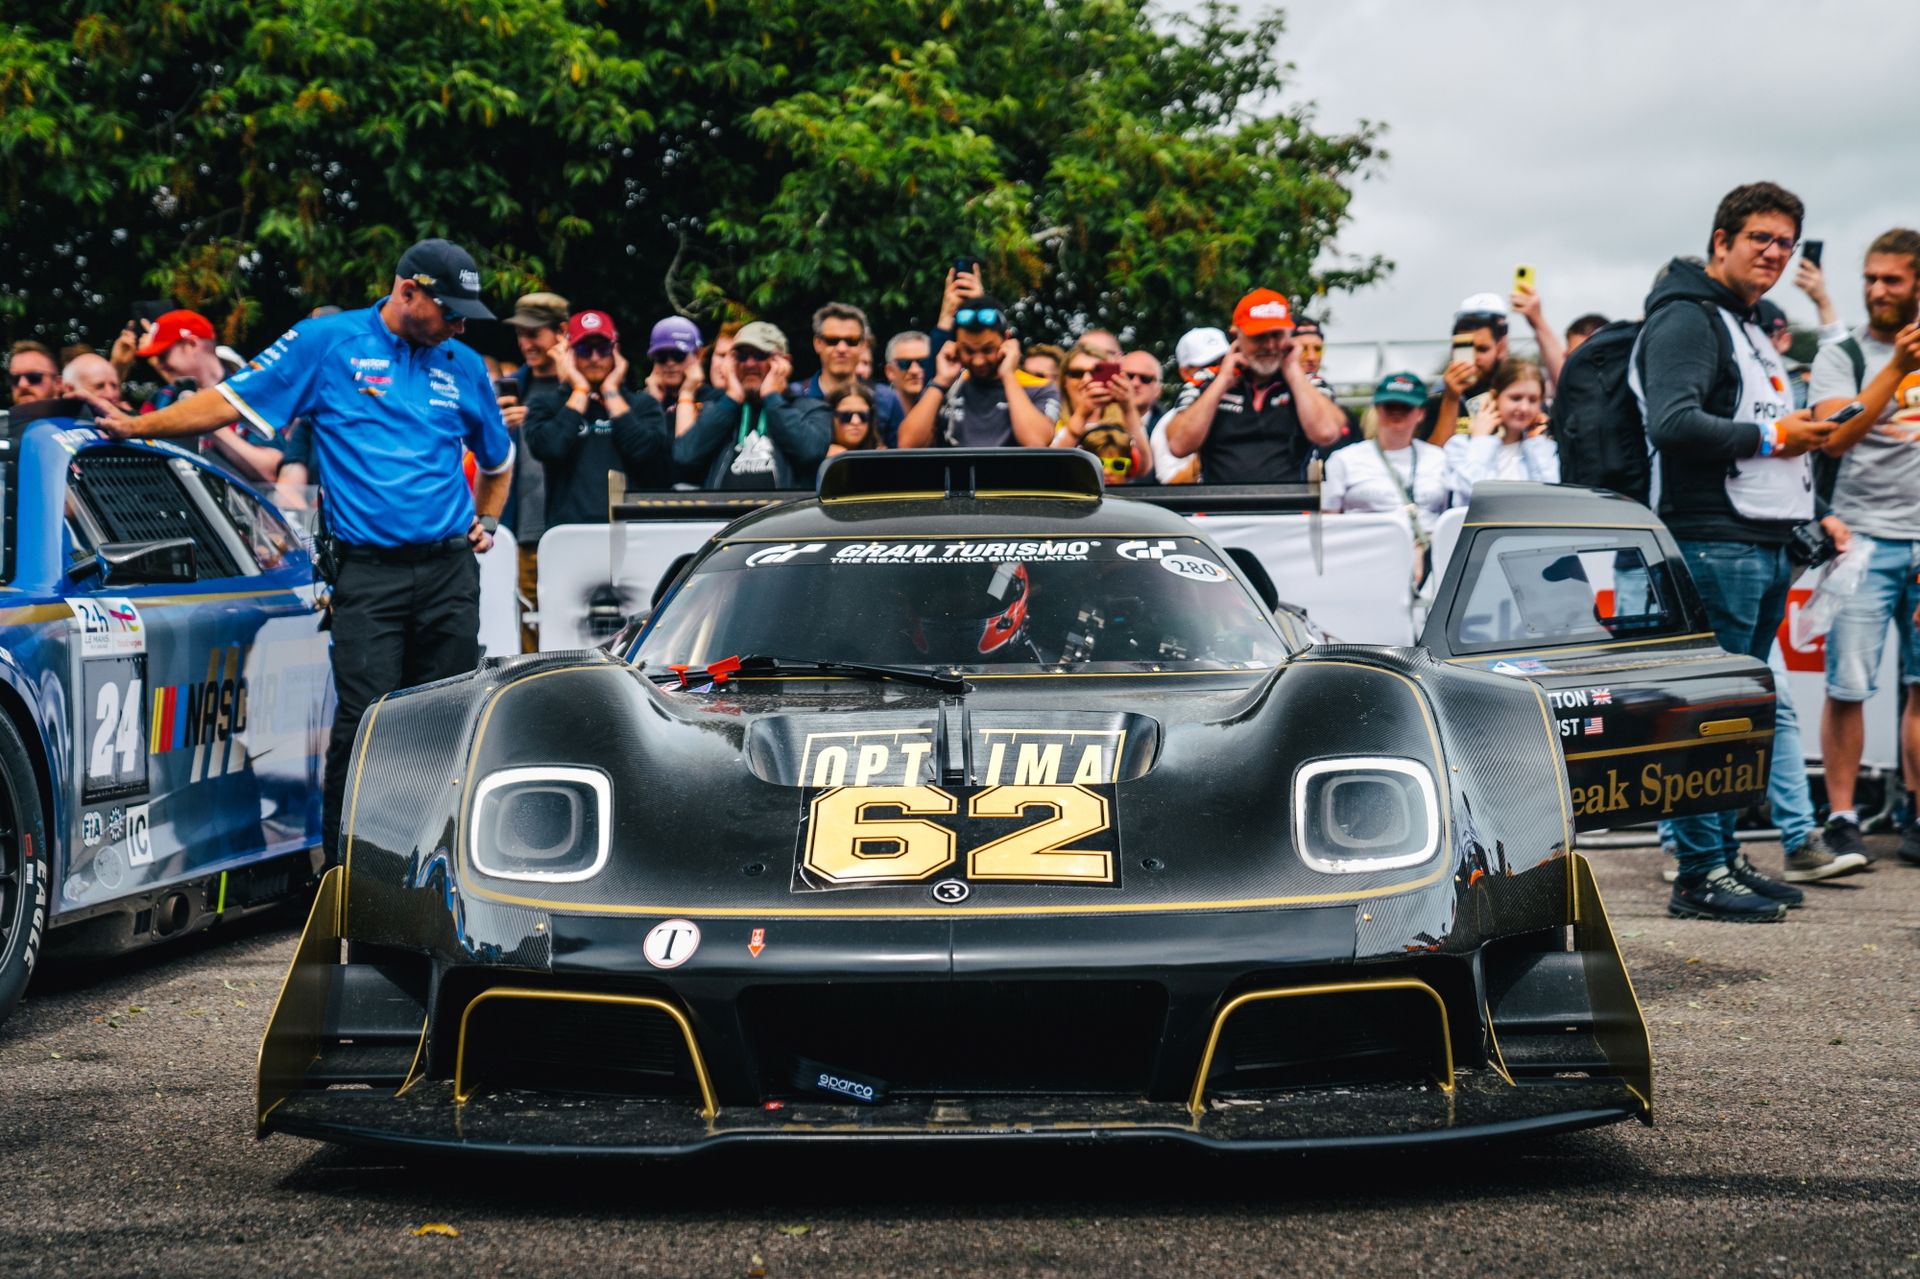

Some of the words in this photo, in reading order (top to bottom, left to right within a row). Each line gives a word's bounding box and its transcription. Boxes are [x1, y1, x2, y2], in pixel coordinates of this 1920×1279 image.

[836, 544, 936, 558] GRAN
[943, 541, 1090, 557] TURISMO
[914, 555, 985, 563] DRIVING
[1171, 560, 1218, 577] 280
[90, 679, 142, 778] 24
[1640, 750, 1766, 814] Special
[129, 814, 148, 857] IC
[803, 784, 1114, 883] 62
[23, 858, 47, 976] EAGLE
[655, 928, 693, 961] T
[818, 1073, 874, 1100] sparco
